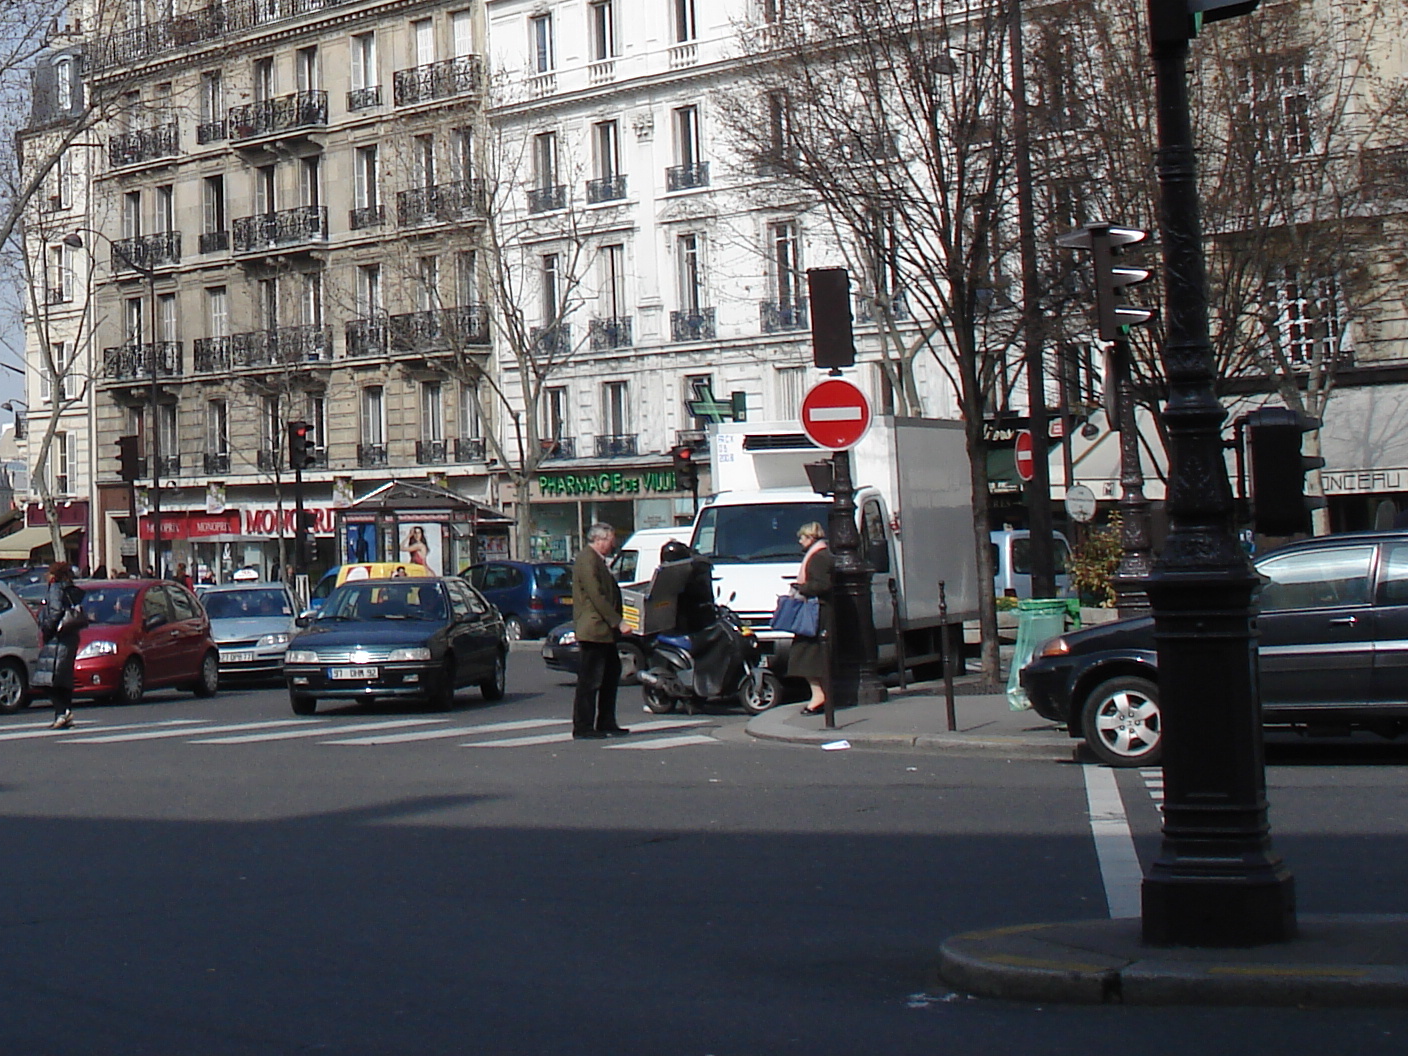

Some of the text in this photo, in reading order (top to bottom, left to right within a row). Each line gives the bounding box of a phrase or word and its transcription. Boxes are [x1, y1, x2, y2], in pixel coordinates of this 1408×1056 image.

[538, 474, 621, 496] PHARMACIE
[625, 479, 639, 490] DE
[197, 522, 231, 532] MONOPRIX
